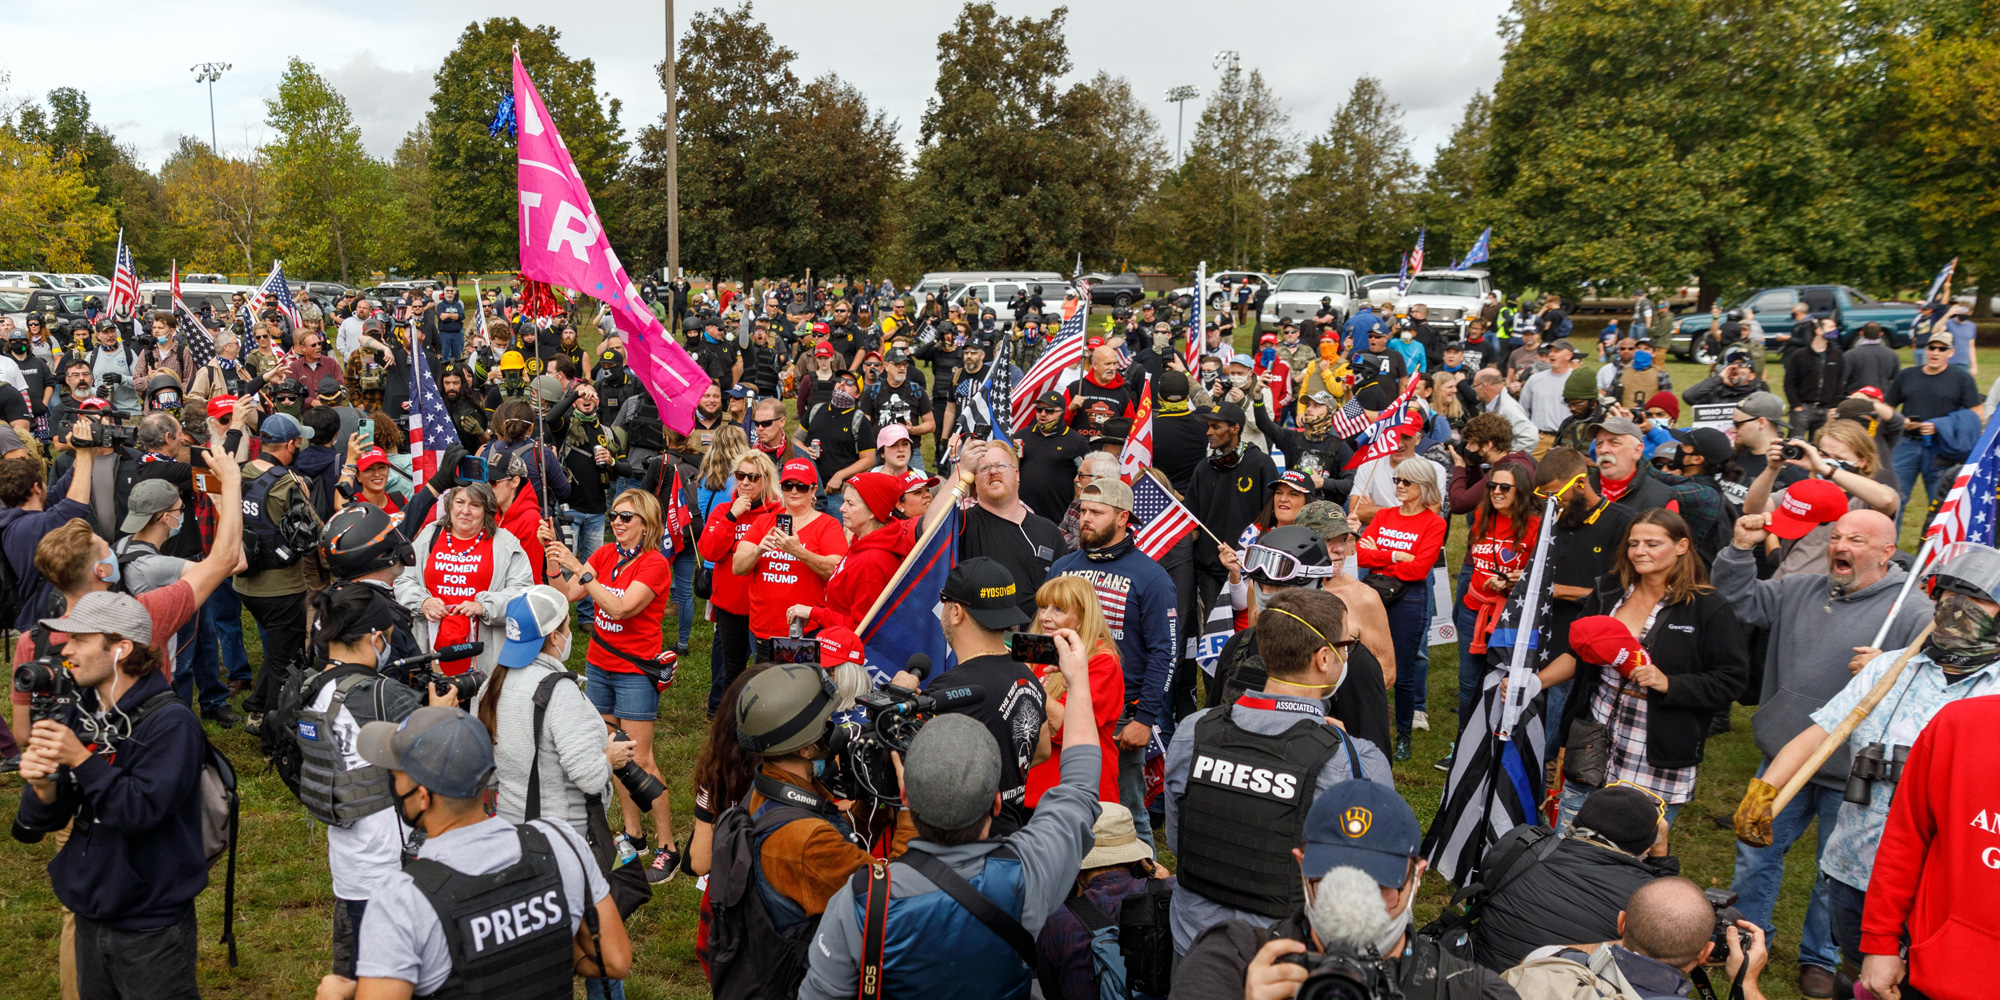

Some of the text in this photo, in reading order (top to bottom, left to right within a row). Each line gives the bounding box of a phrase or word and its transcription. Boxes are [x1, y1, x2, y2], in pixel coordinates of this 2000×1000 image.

[1281, 470, 1306, 480] Trump
[1379, 526, 1418, 542] OREGON
[1376, 536, 1412, 551] WOMEN
[436, 552, 482, 562] OREGON
[434, 562, 478, 573] WOMEN
[769, 562, 790, 572] FOR
[443, 574, 466, 584] FOR
[762, 572, 798, 584] TRUMP
[1061, 569, 1132, 593] AMERICANS
[436, 585, 476, 596] TRUMP
[1170, 657, 1177, 669] WE
[1163, 669, 1176, 692] STAND
[1276, 701, 1314, 713] ASSOCIATED
[1192, 755, 1298, 800] PRESS
[787, 790, 817, 806] Canon
[1002, 789, 1016, 800] WITH
[470, 890, 562, 952] PRESS
[864, 965, 876, 995] EOS
